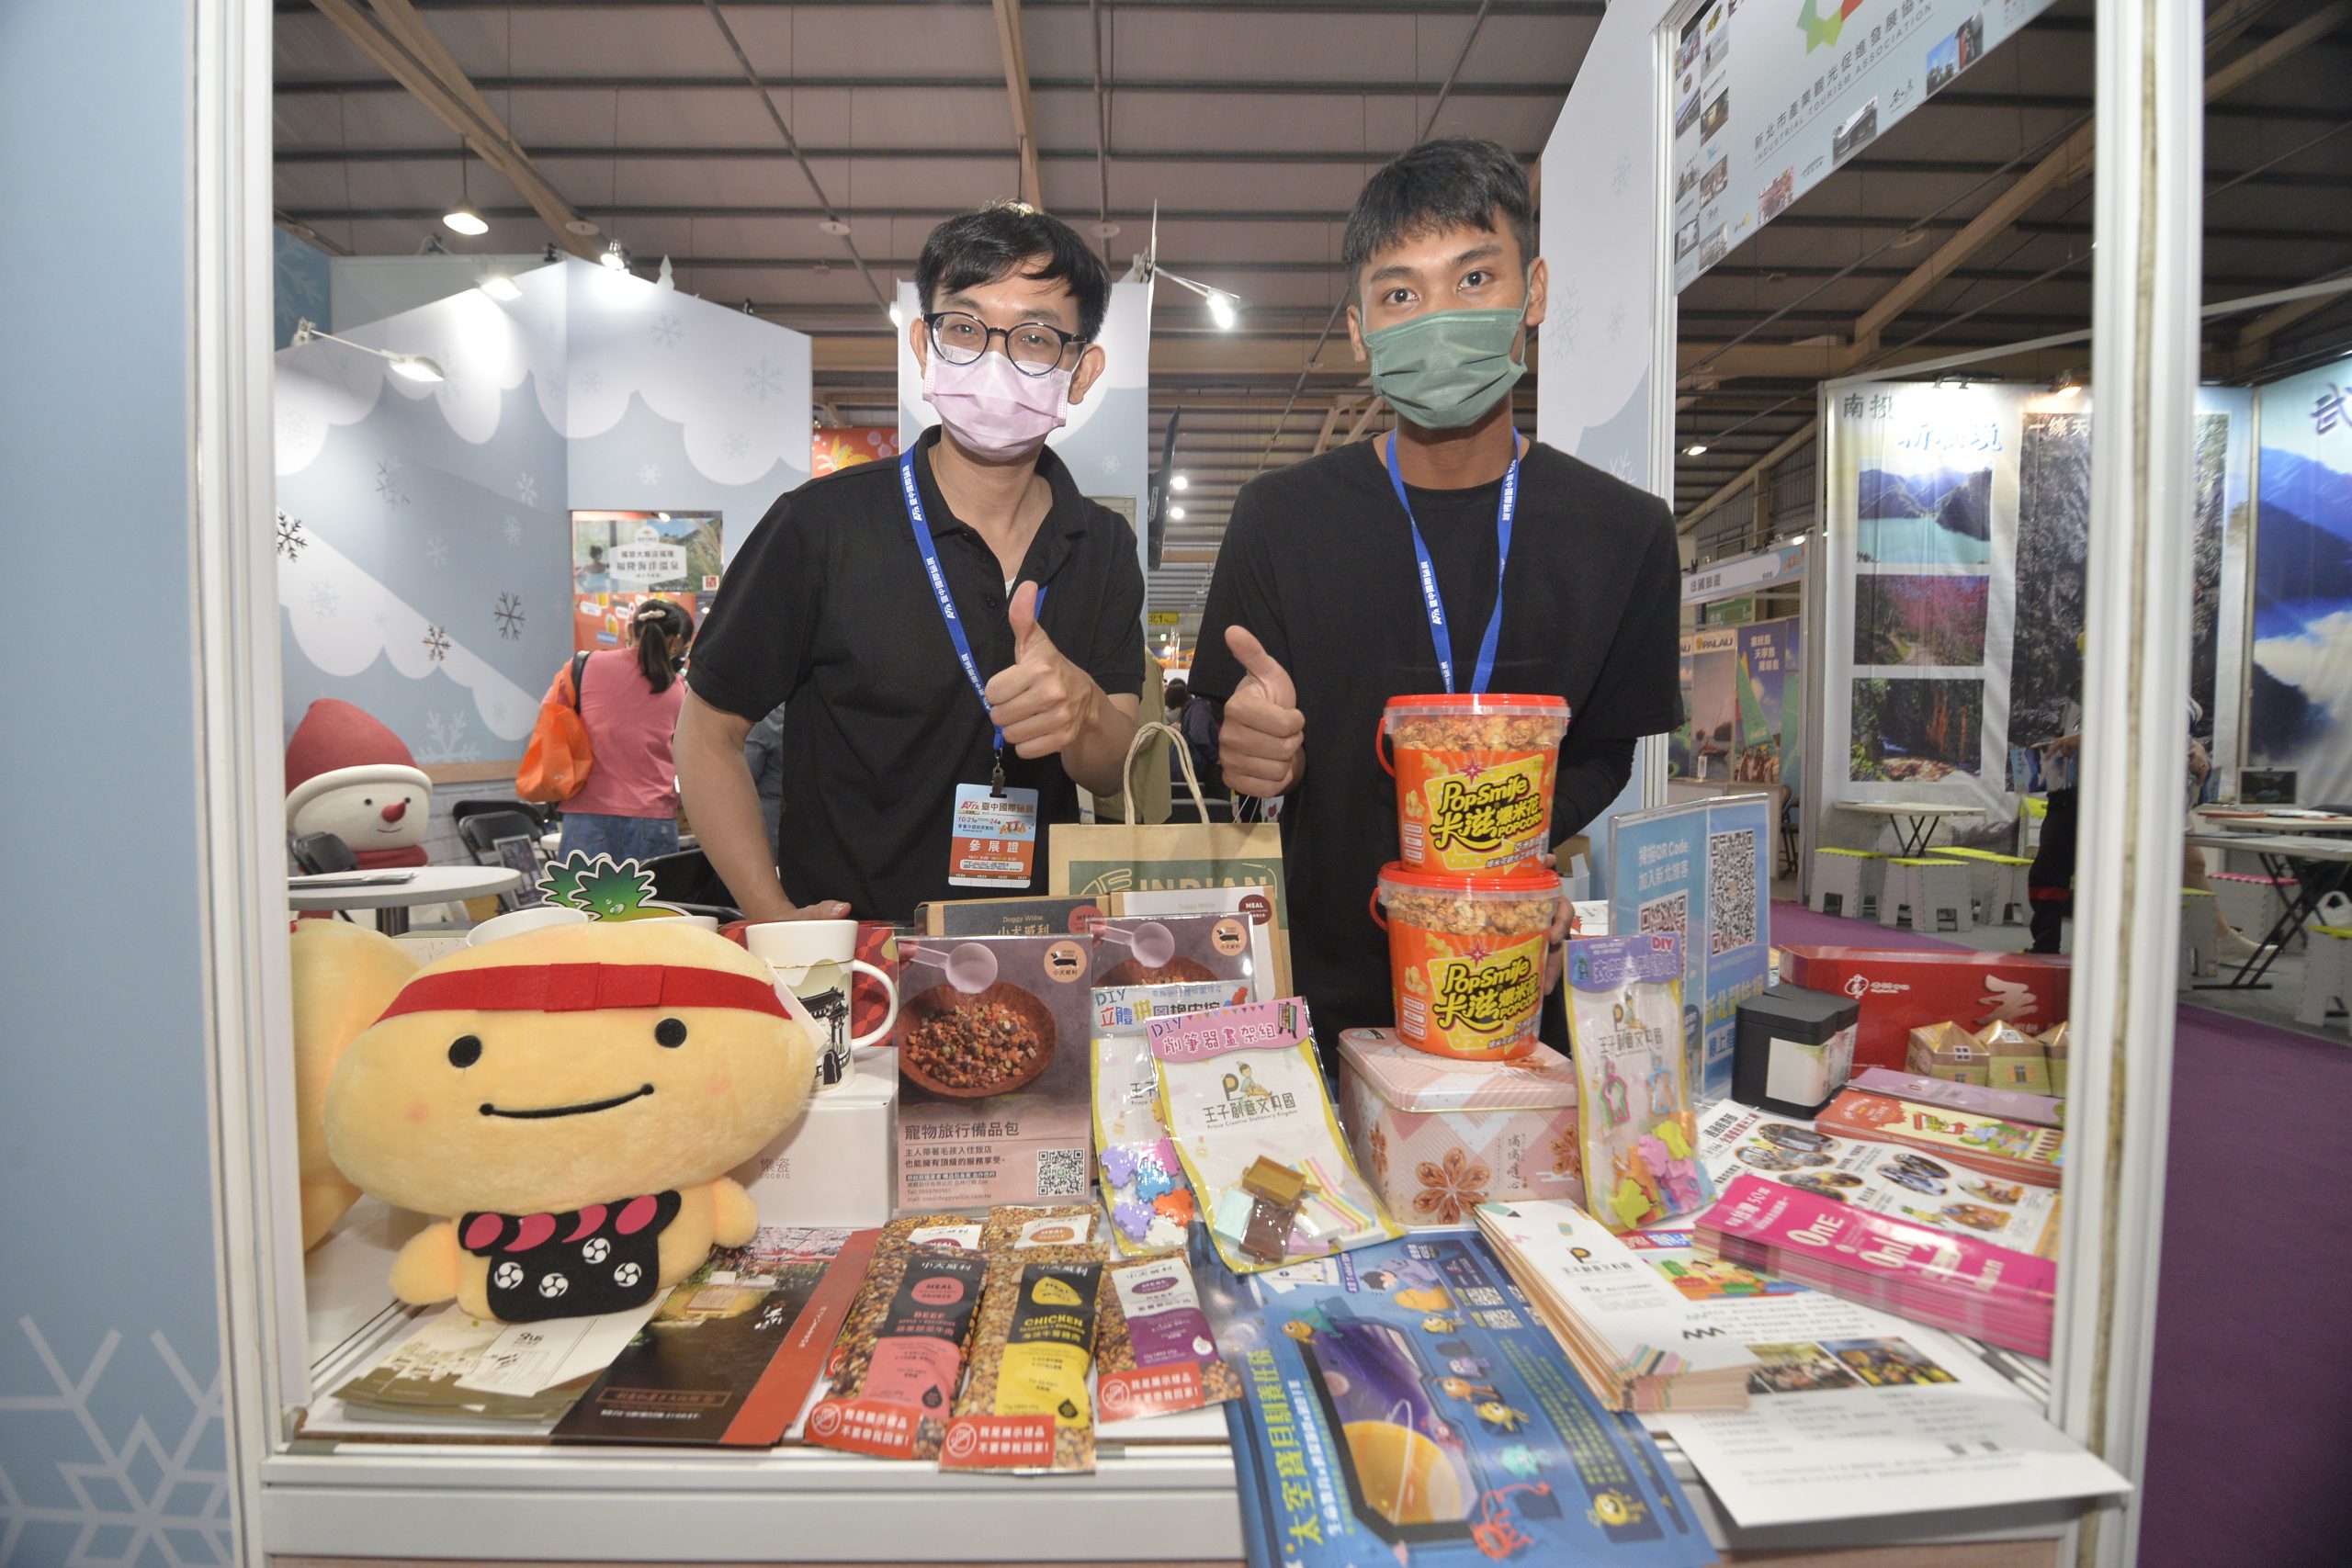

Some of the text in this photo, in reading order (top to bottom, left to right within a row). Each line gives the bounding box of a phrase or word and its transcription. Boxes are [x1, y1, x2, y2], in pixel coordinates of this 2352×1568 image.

[1755, 0, 1928, 150] 新北市產業觀光促進發展協
[1755, 5, 1931, 164] INDUSTRIAL TOURISM ASSOCIATION
[1843, 392, 1893, 420] 南投
[1702, 637, 1734, 649] PALAU
[1497, 812, 1544, 837] POPCORN
[969, 839, 1019, 853] 參展證
[1651, 935, 1674, 952] DIY
[1095, 988, 1126, 1007] DIY
[1151, 1016, 1182, 1038] DIY
[1163, 1023, 1277, 1055] 削筆器畫架組
[1204, 1093, 1297, 1123] 王子創意文具國
[905, 1122, 1020, 1140] 寵物旅行備品包
[905, 1145, 992, 1157] 主人帶著毛孩入住飯店
[922, 1261, 972, 1271] 小犬威利
[914, 1311, 946, 1319] BEEF
[1024, 1314, 1084, 1328] CHICKEN
[843, 1408, 908, 1430] 我是展示樣品
[979, 1426, 1046, 1438] 我是展示樣品
